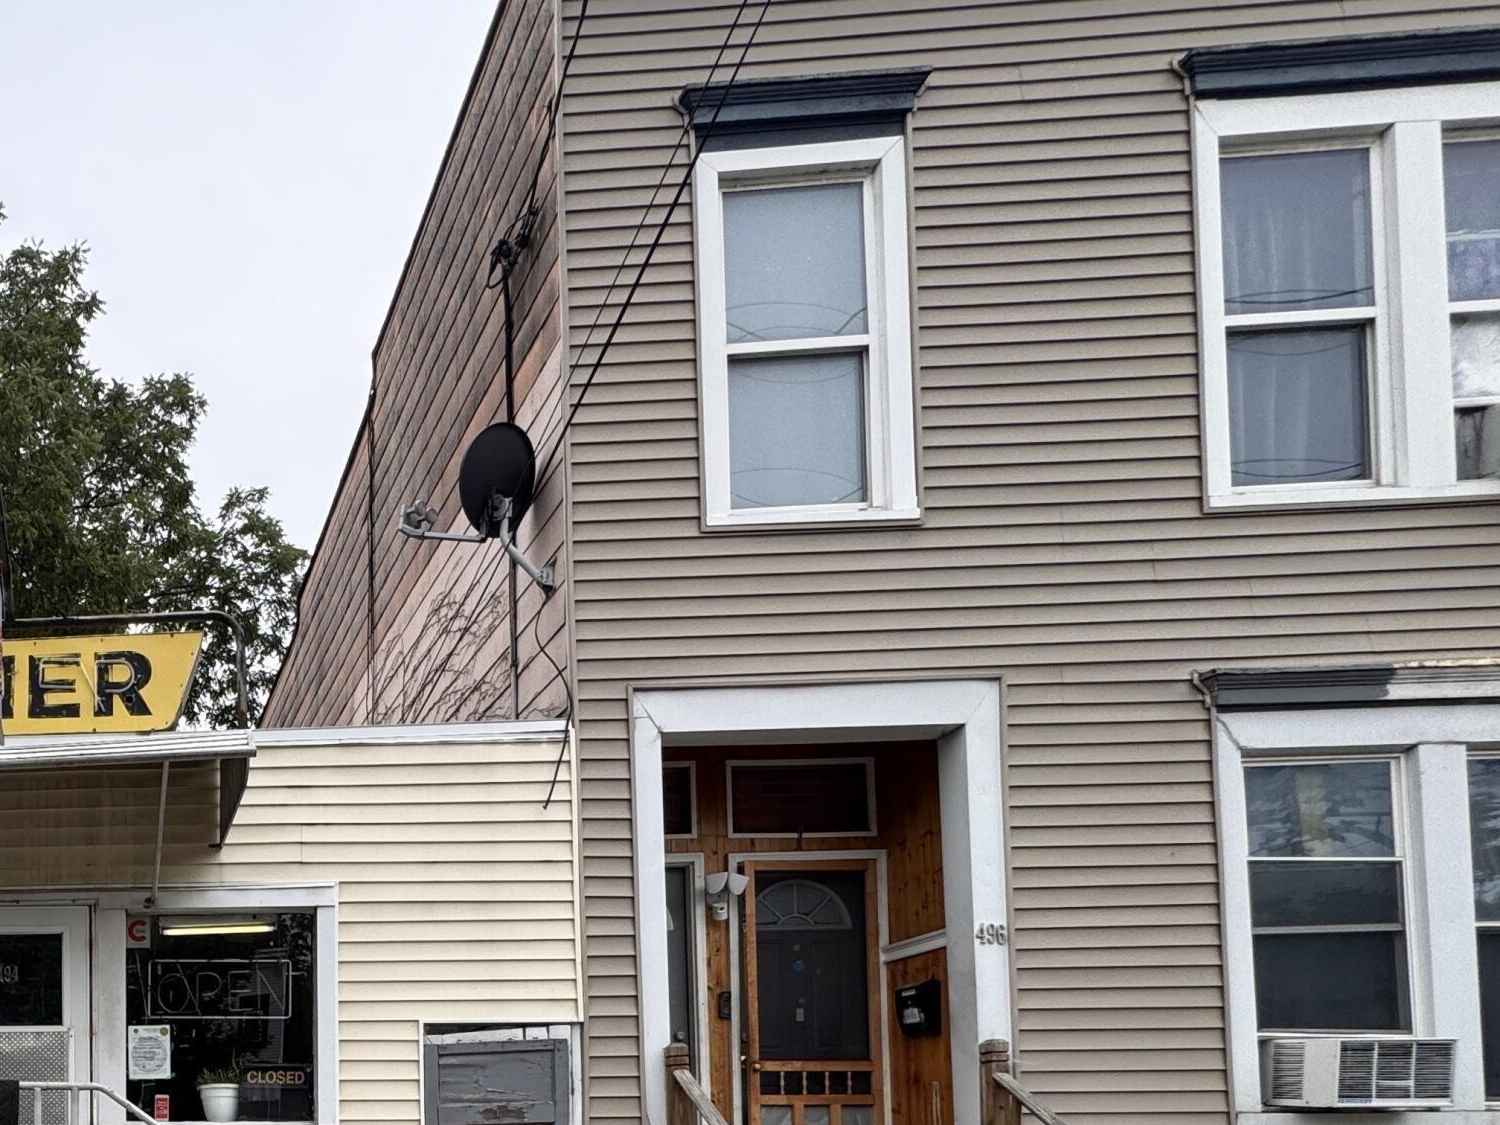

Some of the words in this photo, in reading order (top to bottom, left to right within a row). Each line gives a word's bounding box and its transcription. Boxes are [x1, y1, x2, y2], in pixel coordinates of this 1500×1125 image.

[975, 922, 1006, 946] 496
[158, 970, 285, 1014] OPEN
[246, 1070, 305, 1084] CLOSED
